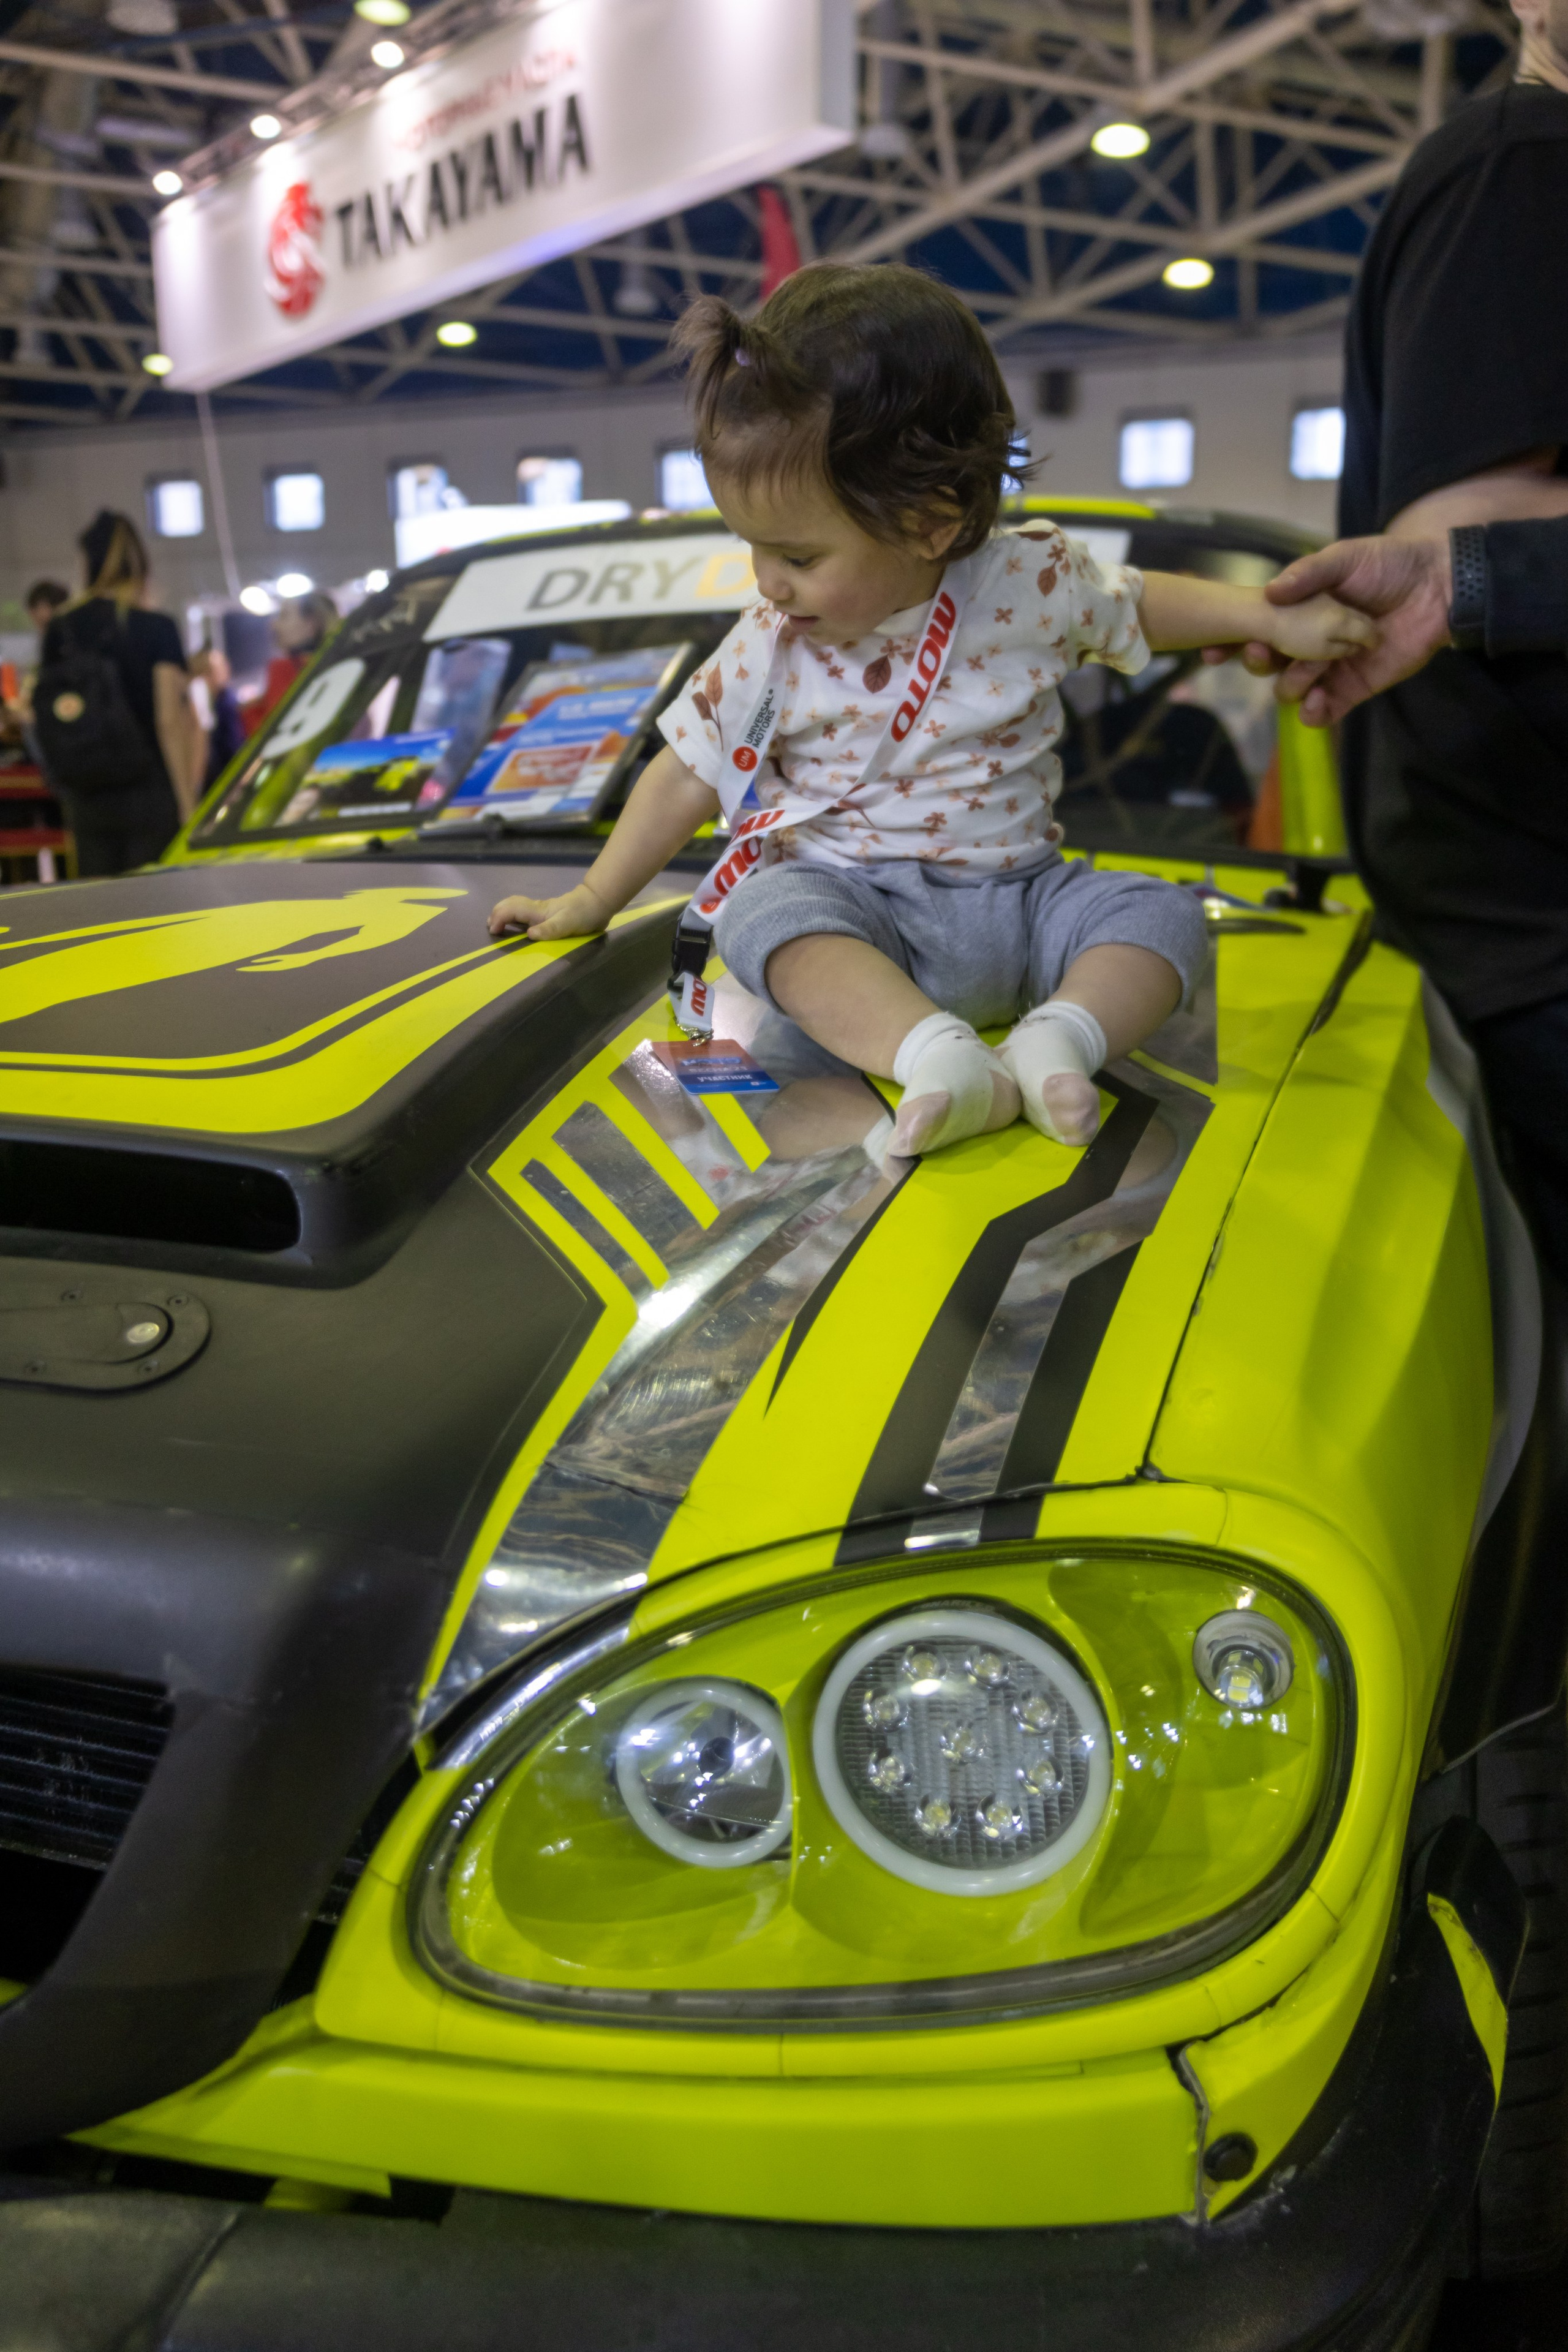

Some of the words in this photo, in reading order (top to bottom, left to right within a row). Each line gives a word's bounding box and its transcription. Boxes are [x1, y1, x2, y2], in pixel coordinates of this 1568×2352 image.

[335, 93, 592, 271] TAKAYAMA
[891, 591, 957, 742] MOTO
[738, 750, 752, 767] UM
[752, 709, 775, 748] MOTORS
